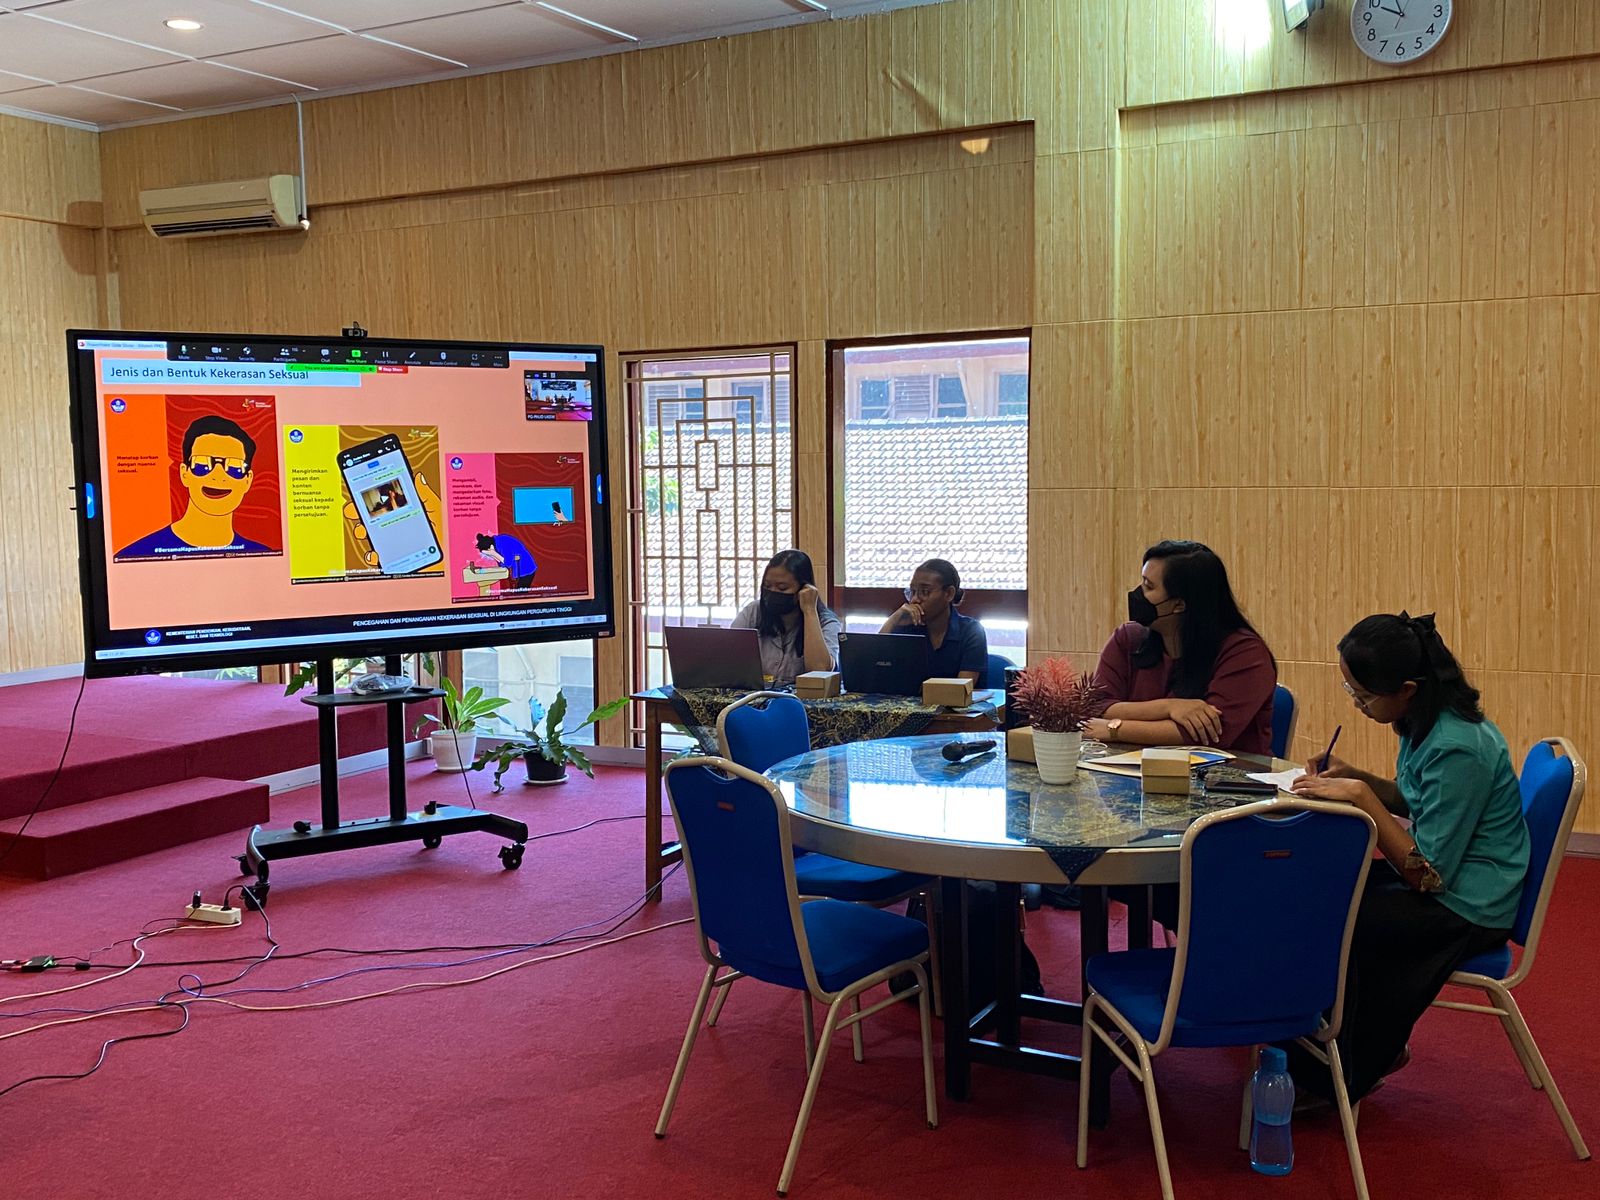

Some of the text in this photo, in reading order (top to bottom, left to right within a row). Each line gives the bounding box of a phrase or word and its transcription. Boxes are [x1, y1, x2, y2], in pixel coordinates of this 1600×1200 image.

[1433, 4, 1443, 18] 3
[1363, 12, 1372, 26] 9
[1367, 28, 1376, 41] 8
[1425, 23, 1435, 36] 4
[1380, 40, 1388, 53] 7
[1395, 42, 1405, 56] 6
[1414, 37, 1422, 49] 5
[110, 366, 309, 380] Jenis dan Bentuk Kekerasan Seksual
[401, 616, 437, 624] PENANGANAN
[495, 609, 527, 617] LINGKUNGAN
